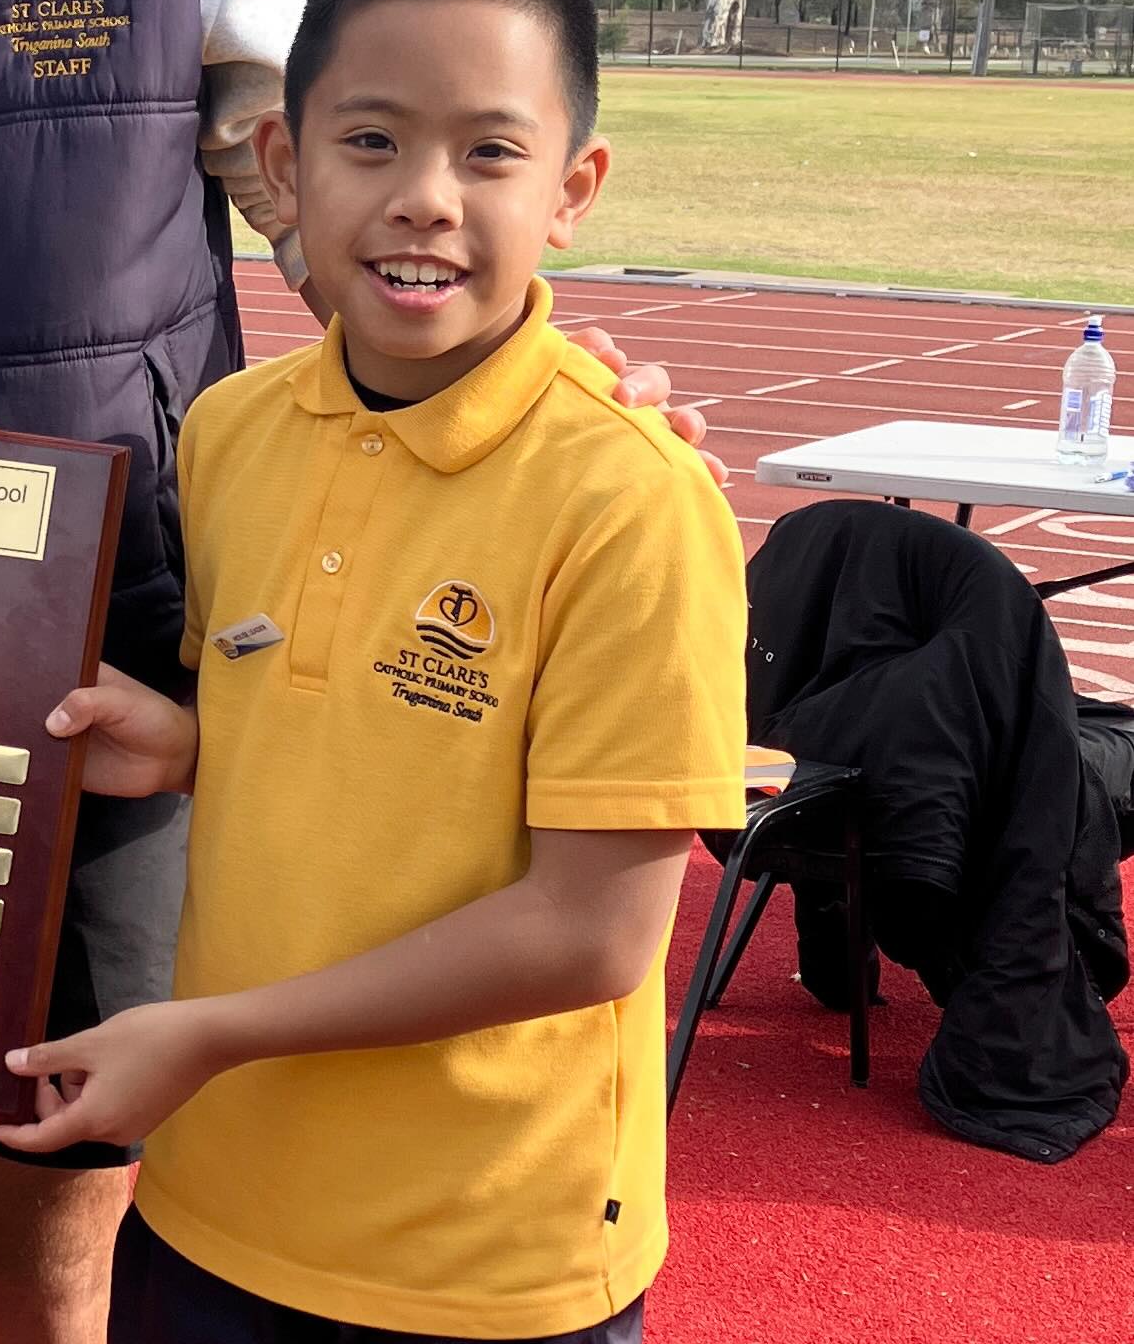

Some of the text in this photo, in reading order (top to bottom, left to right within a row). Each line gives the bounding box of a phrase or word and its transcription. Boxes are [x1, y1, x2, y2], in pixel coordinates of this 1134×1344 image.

[11, 2, 31, 19] ST
[42, 18, 87, 32] PRIMARY
[89, 15, 131, 29] SCHOOL
[10, 31, 111, 56] Truganina South
[33, 58, 92, 79] STAFF
[399, 649, 489, 689] ST CLARE'S
[373, 661, 499, 708] CATHOLIC PRIMARY SCHOO
[391, 681, 452, 713] Truganina
